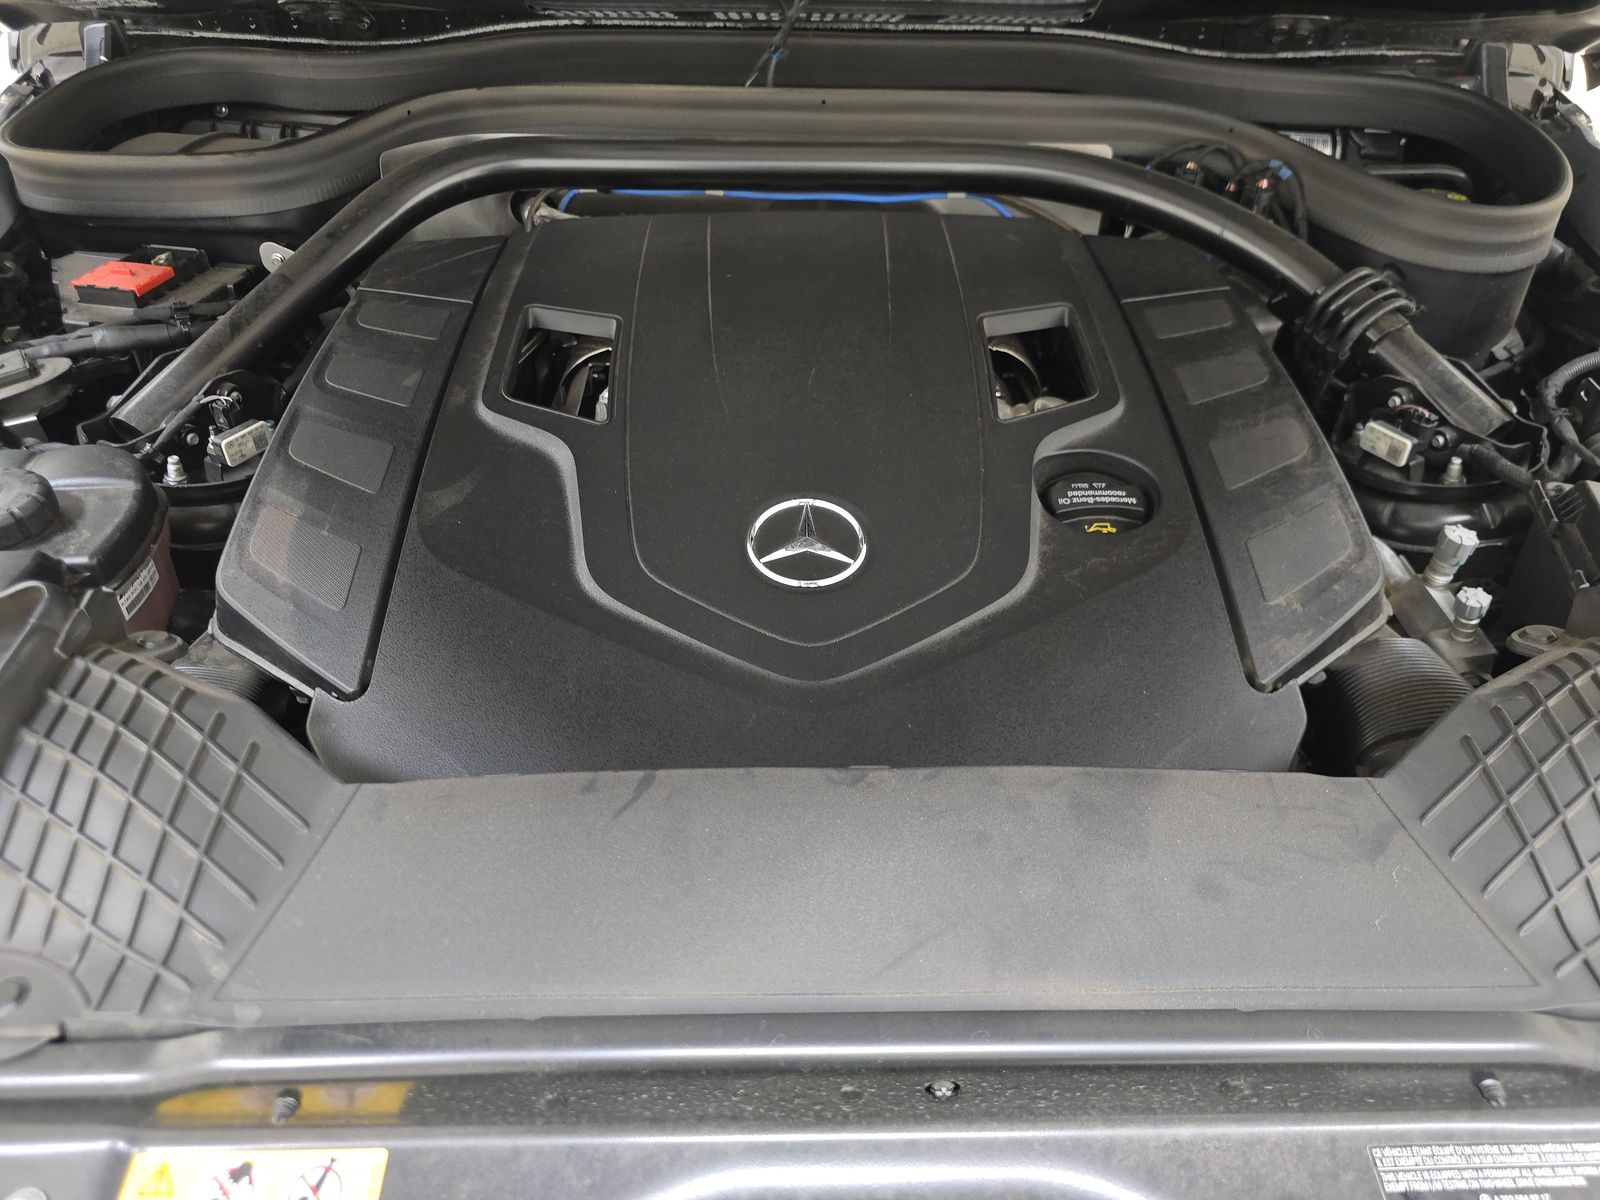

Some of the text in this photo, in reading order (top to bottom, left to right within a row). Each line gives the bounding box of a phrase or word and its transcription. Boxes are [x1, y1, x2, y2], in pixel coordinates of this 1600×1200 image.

[1067, 490, 1126, 498] recommended
[1058, 497, 1137, 505] Mercedes-Benz Oil
